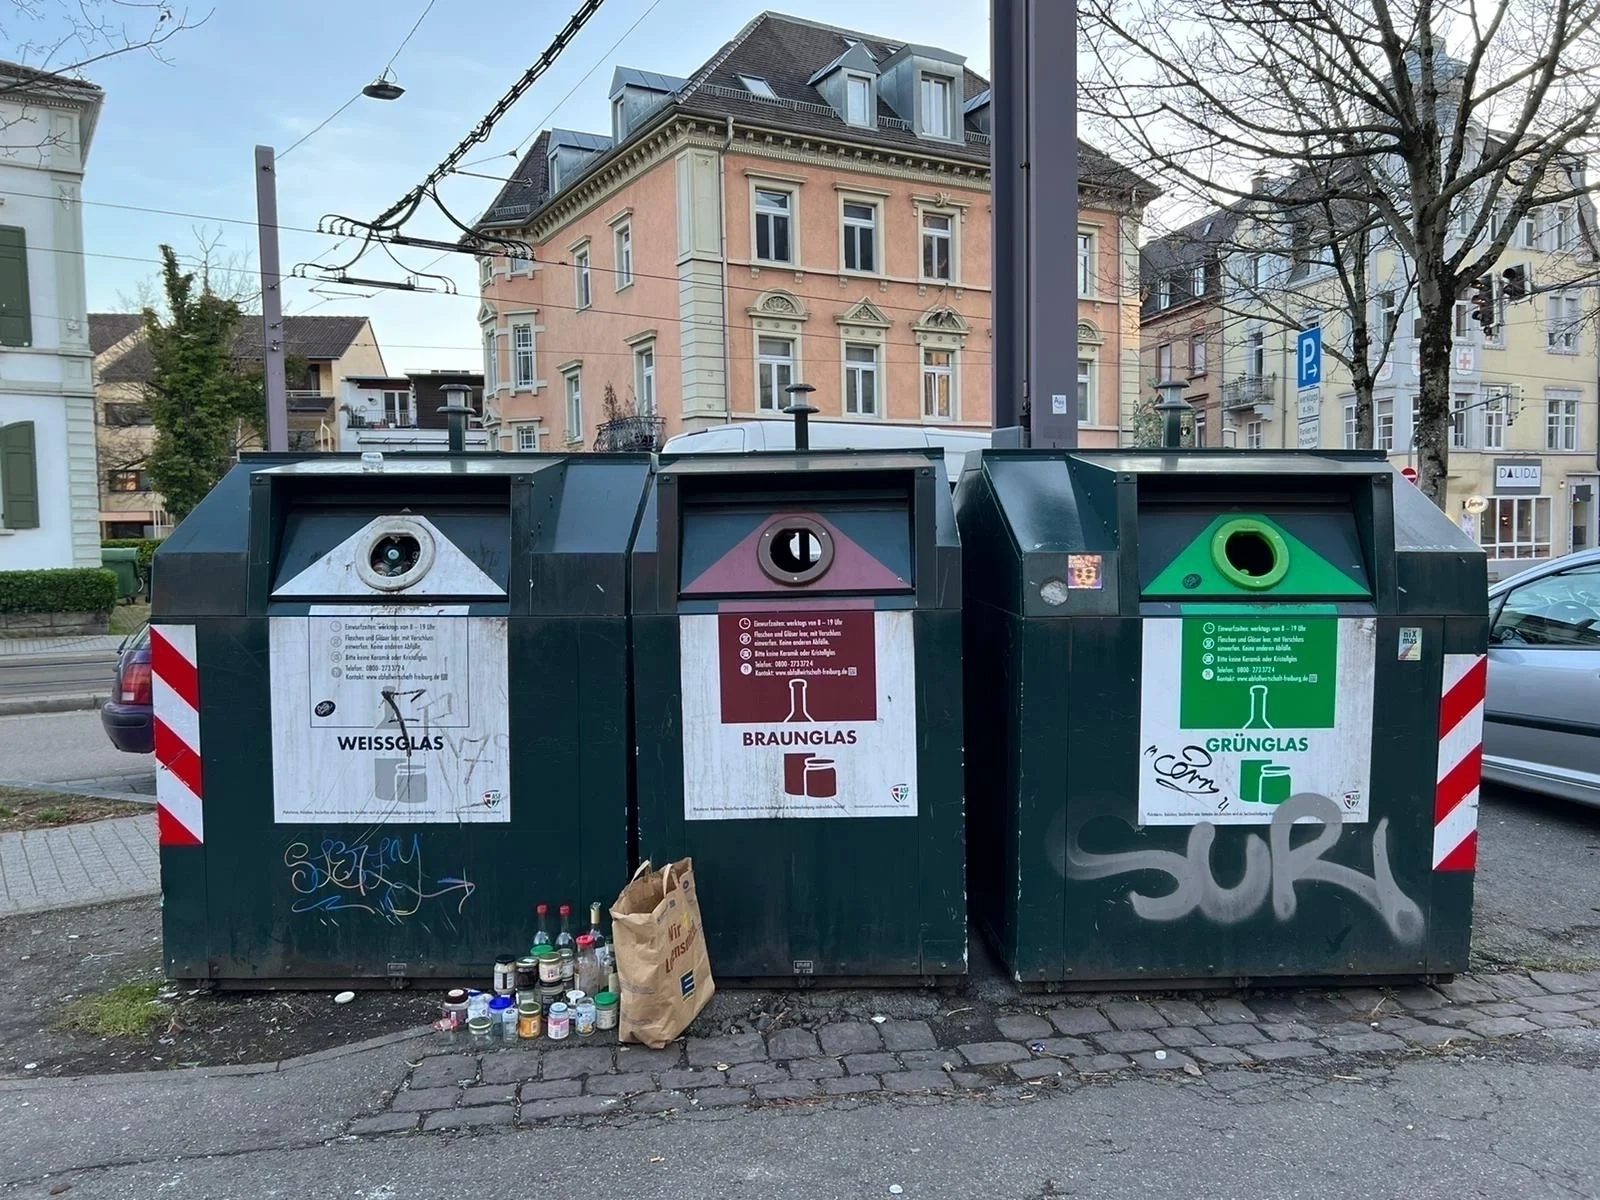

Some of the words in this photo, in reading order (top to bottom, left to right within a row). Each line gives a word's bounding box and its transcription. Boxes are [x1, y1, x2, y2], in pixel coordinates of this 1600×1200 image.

[1302, 337, 1315, 380] P
[1500, 467, 1538, 479] DALIDA
[786, 619, 807, 627] werktags
[811, 649, 836, 657] Kristallglas
[337, 736, 444, 751] WEISSGLAS
[743, 730, 857, 746] BRAUNGLAS
[1206, 733, 1308, 752] GRÜNGLAS
